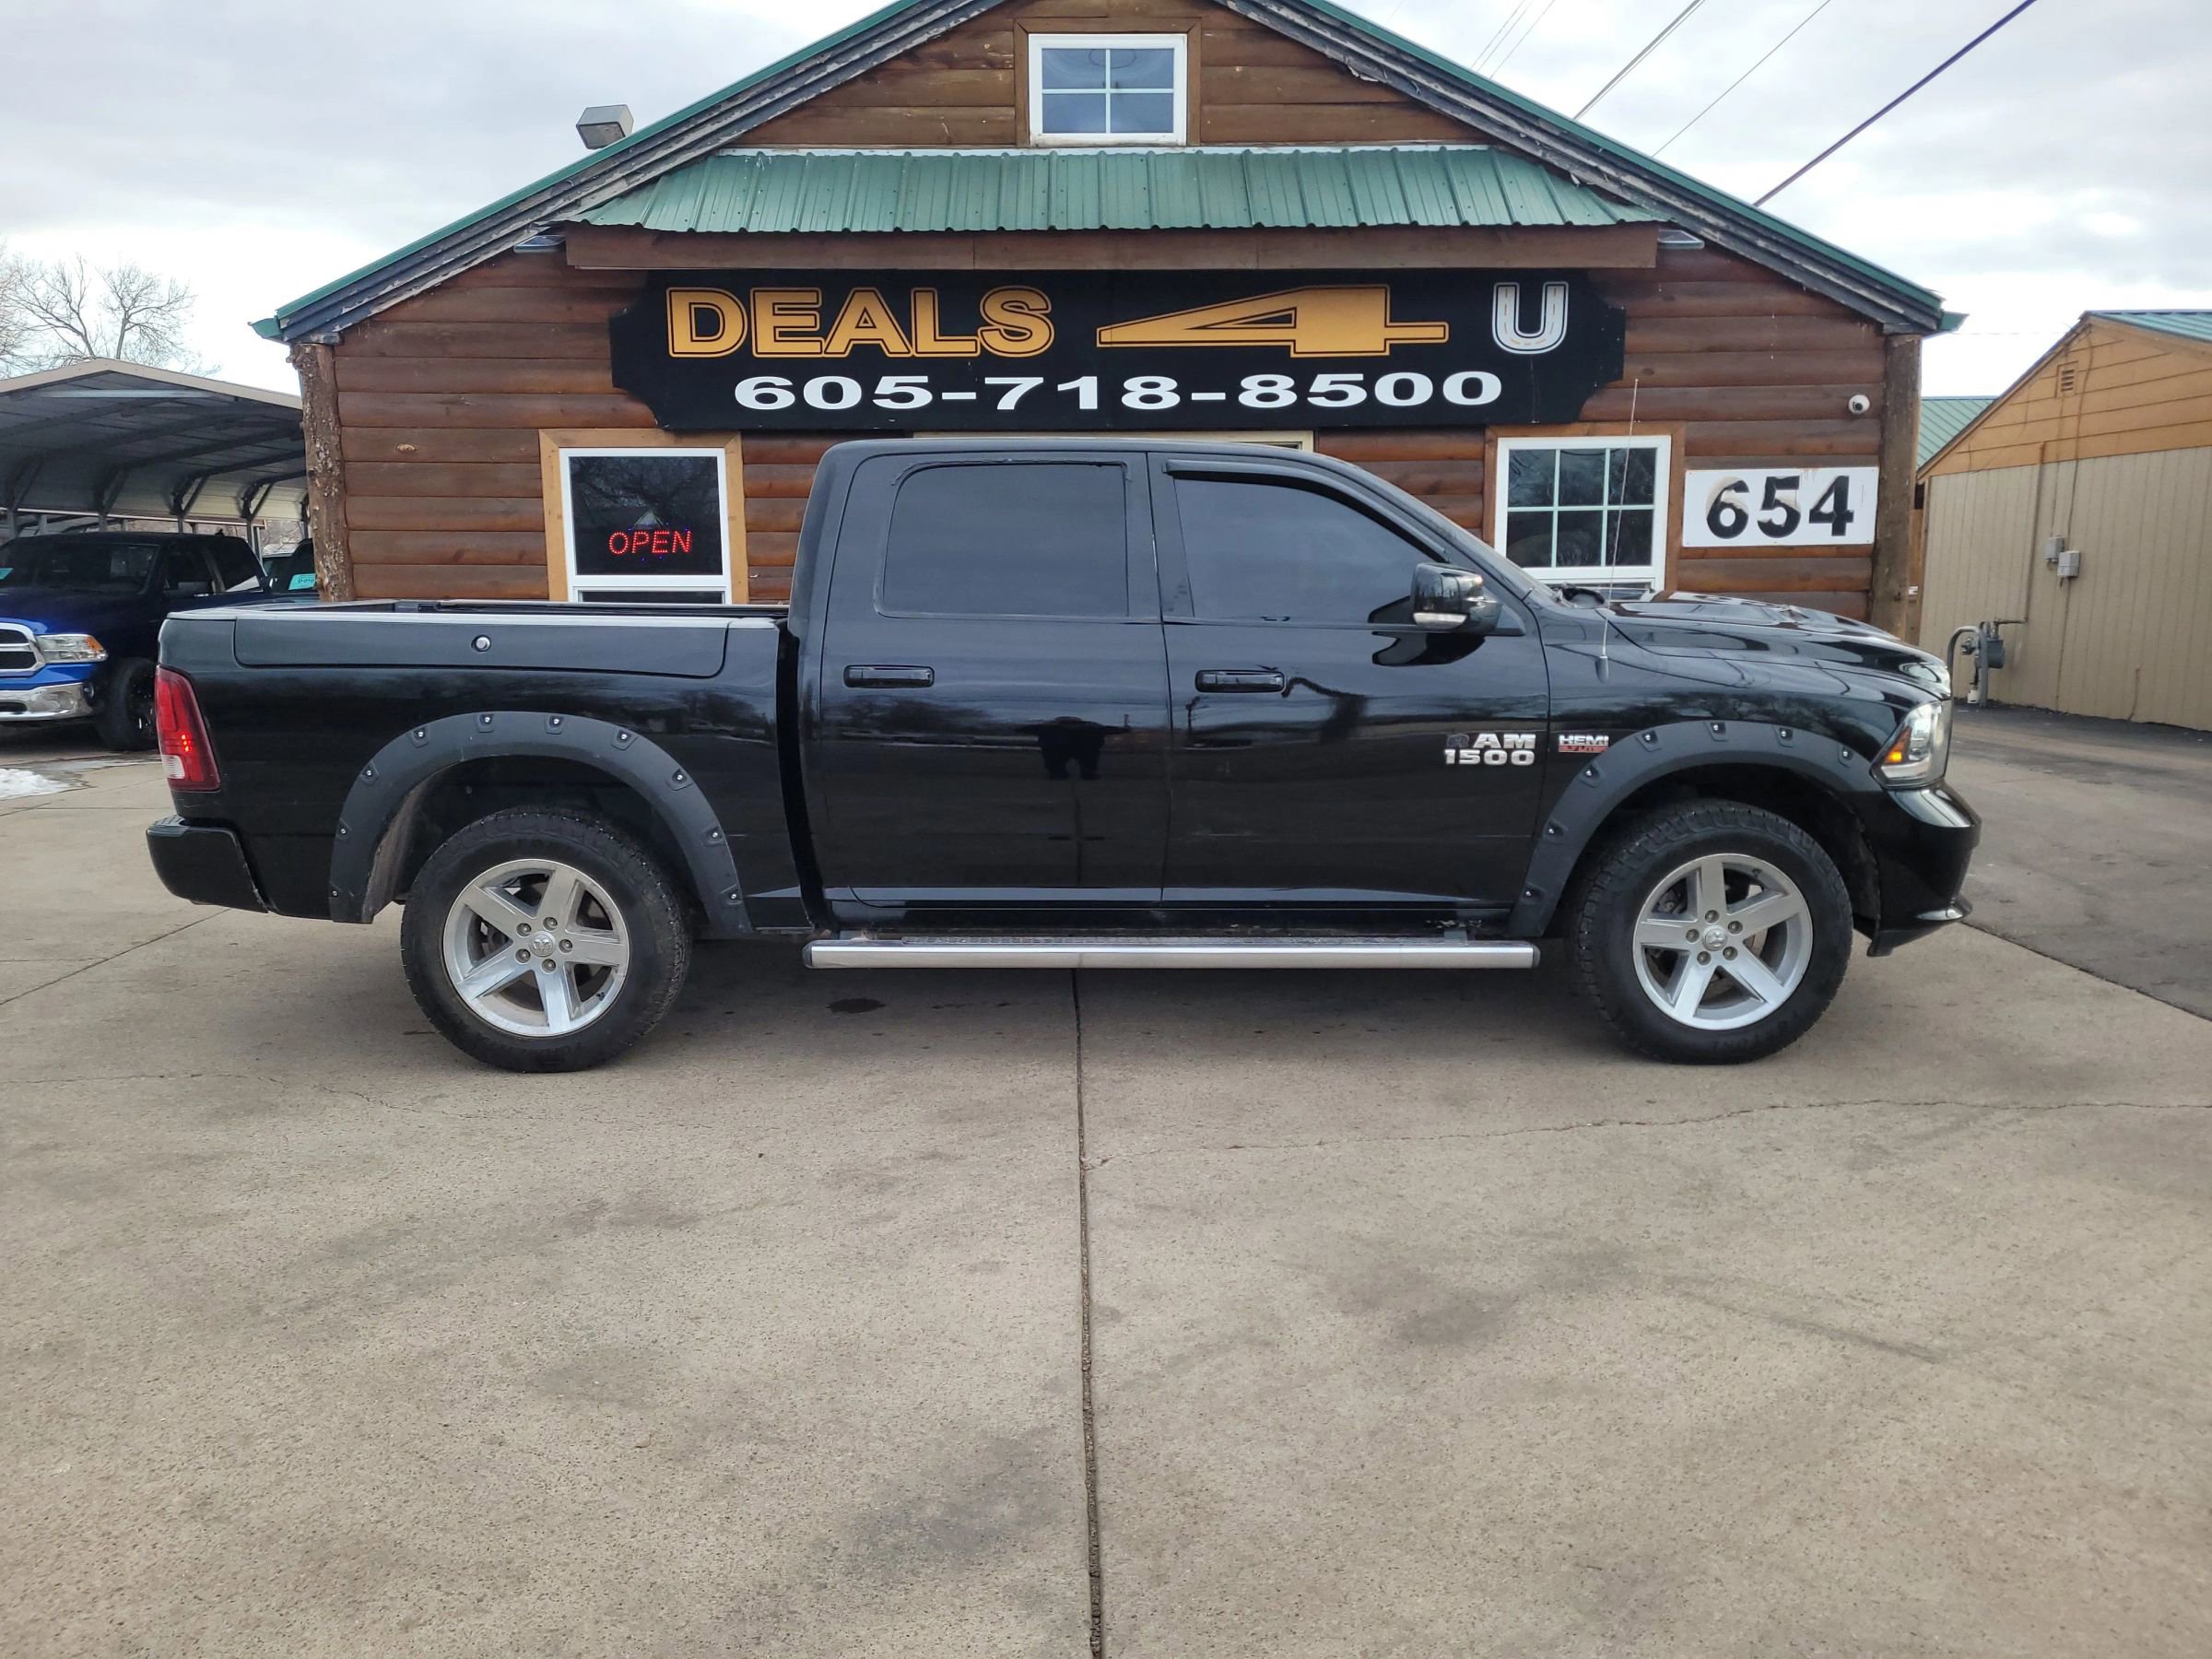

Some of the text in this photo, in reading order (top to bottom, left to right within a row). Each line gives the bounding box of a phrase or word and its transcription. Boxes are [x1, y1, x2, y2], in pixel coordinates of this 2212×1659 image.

[666, 281, 1569, 358] DEALS 4 U
[734, 370, 1502, 411] 605-718-8500
[1706, 475, 1854, 540] 654
[608, 530, 693, 555] OPEN
[1443, 748, 1535, 766] 1500
[1558, 735, 1610, 747] HEMI
